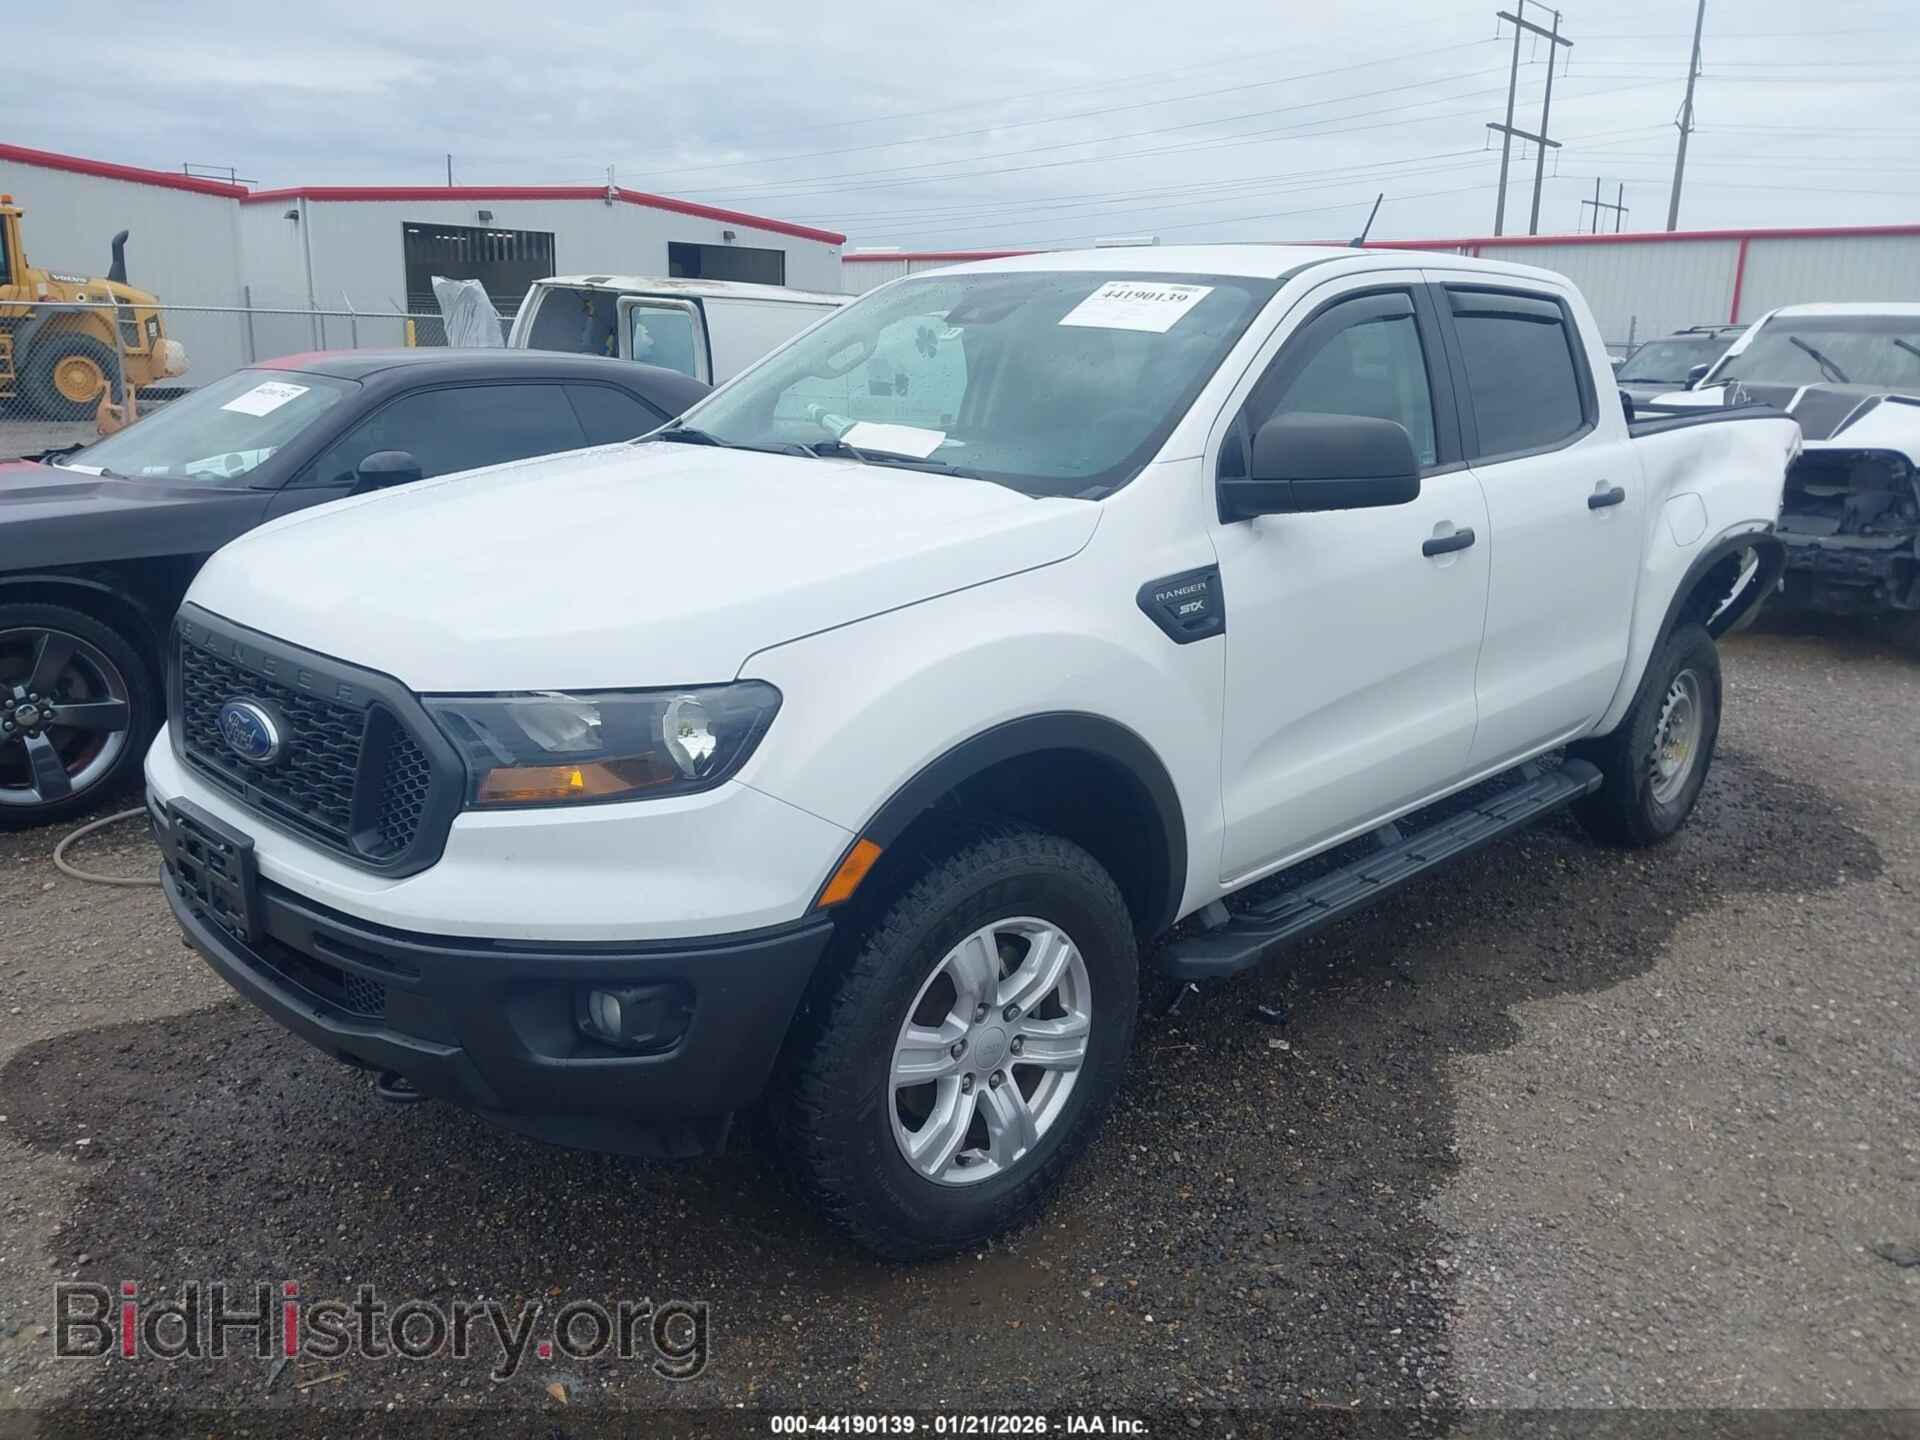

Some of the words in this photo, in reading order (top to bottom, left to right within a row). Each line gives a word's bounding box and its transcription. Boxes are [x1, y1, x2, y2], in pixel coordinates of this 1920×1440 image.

[52, 274, 87, 283] VOLVO
[1104, 289, 1189, 303] 44190139
[1156, 582, 1207, 602] RANGER
[1179, 600, 1205, 615] STX
[226, 709, 259, 752] Ford
